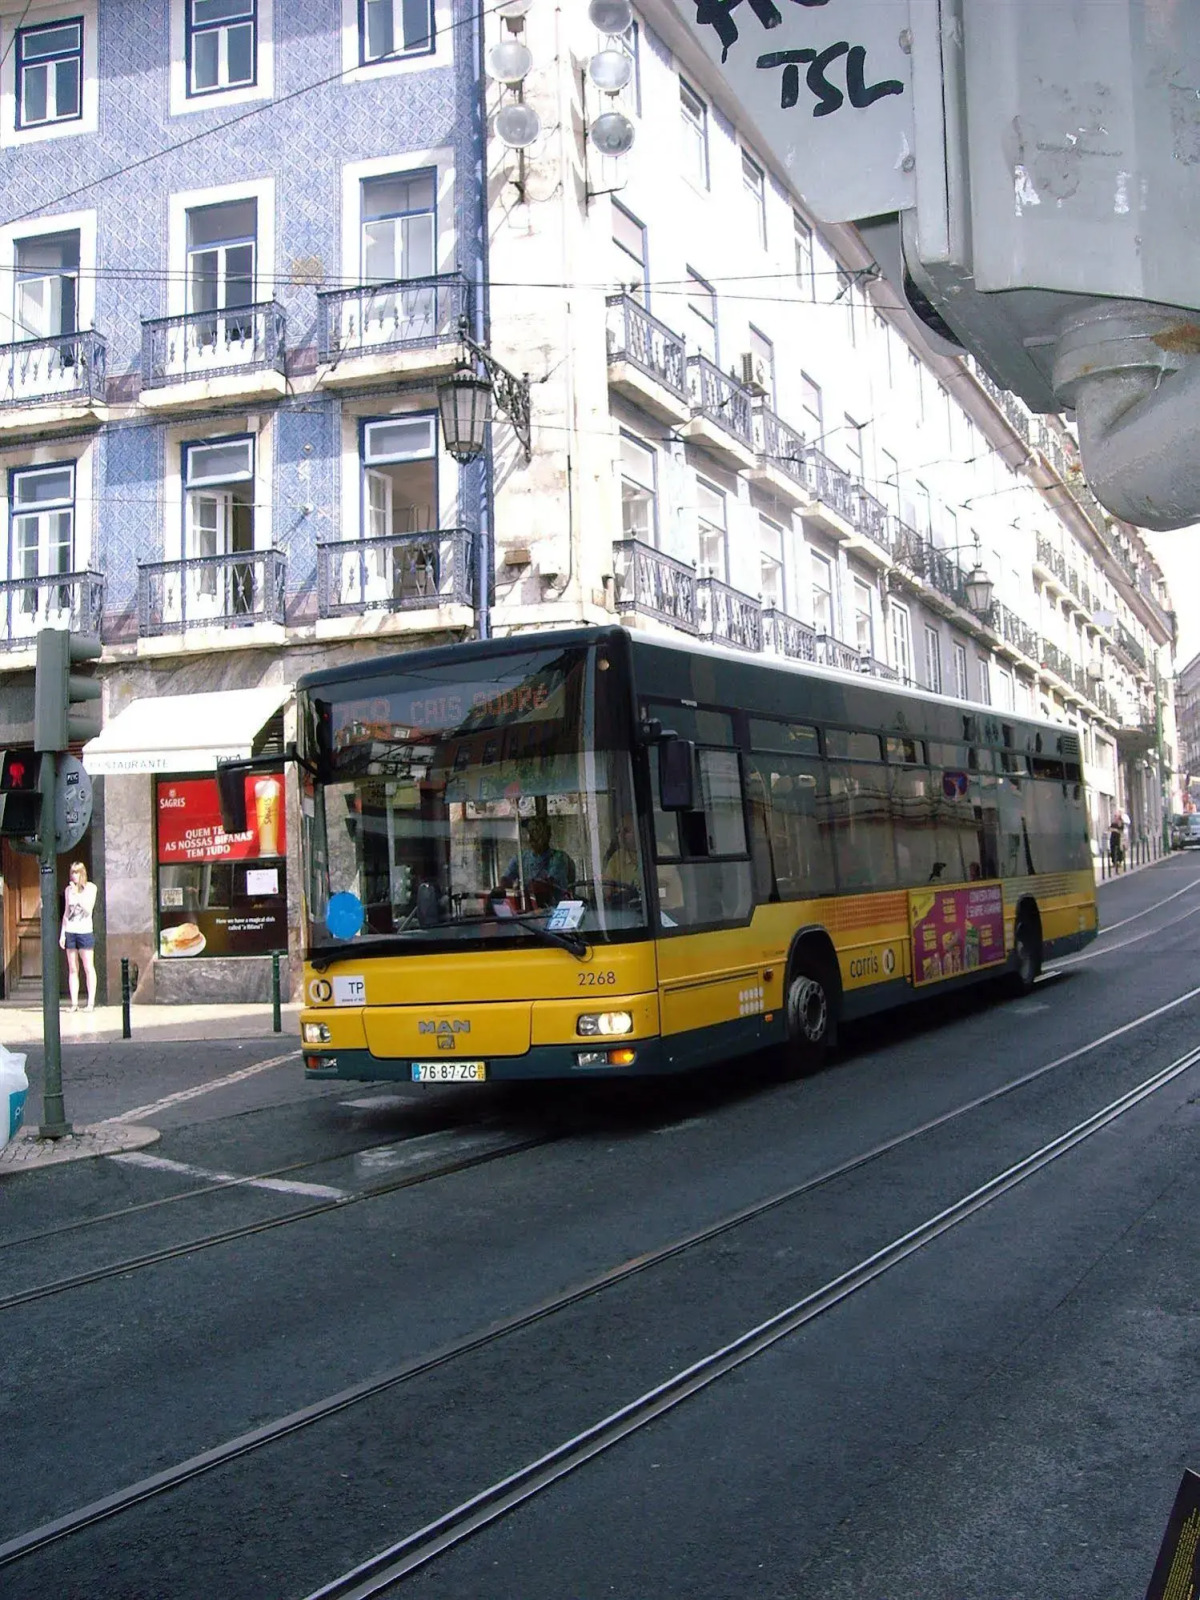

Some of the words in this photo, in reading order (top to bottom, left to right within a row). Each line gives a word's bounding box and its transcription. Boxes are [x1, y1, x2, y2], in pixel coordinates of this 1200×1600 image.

[756, 41, 904, 117] TSL
[160, 797, 186, 809] SAGRES
[185, 827, 211, 840] QUEM
[212, 825, 226, 836] TE
[165, 841, 177, 852] AS
[178, 836, 213, 850] NOSSAS
[214, 829, 254, 846] BIFANAS
[186, 848, 205, 859] TEM
[206, 844, 231, 857] TUDO
[577, 971, 616, 986] 2268
[348, 981, 364, 994] TP
[418, 1019, 471, 1034] MAN
